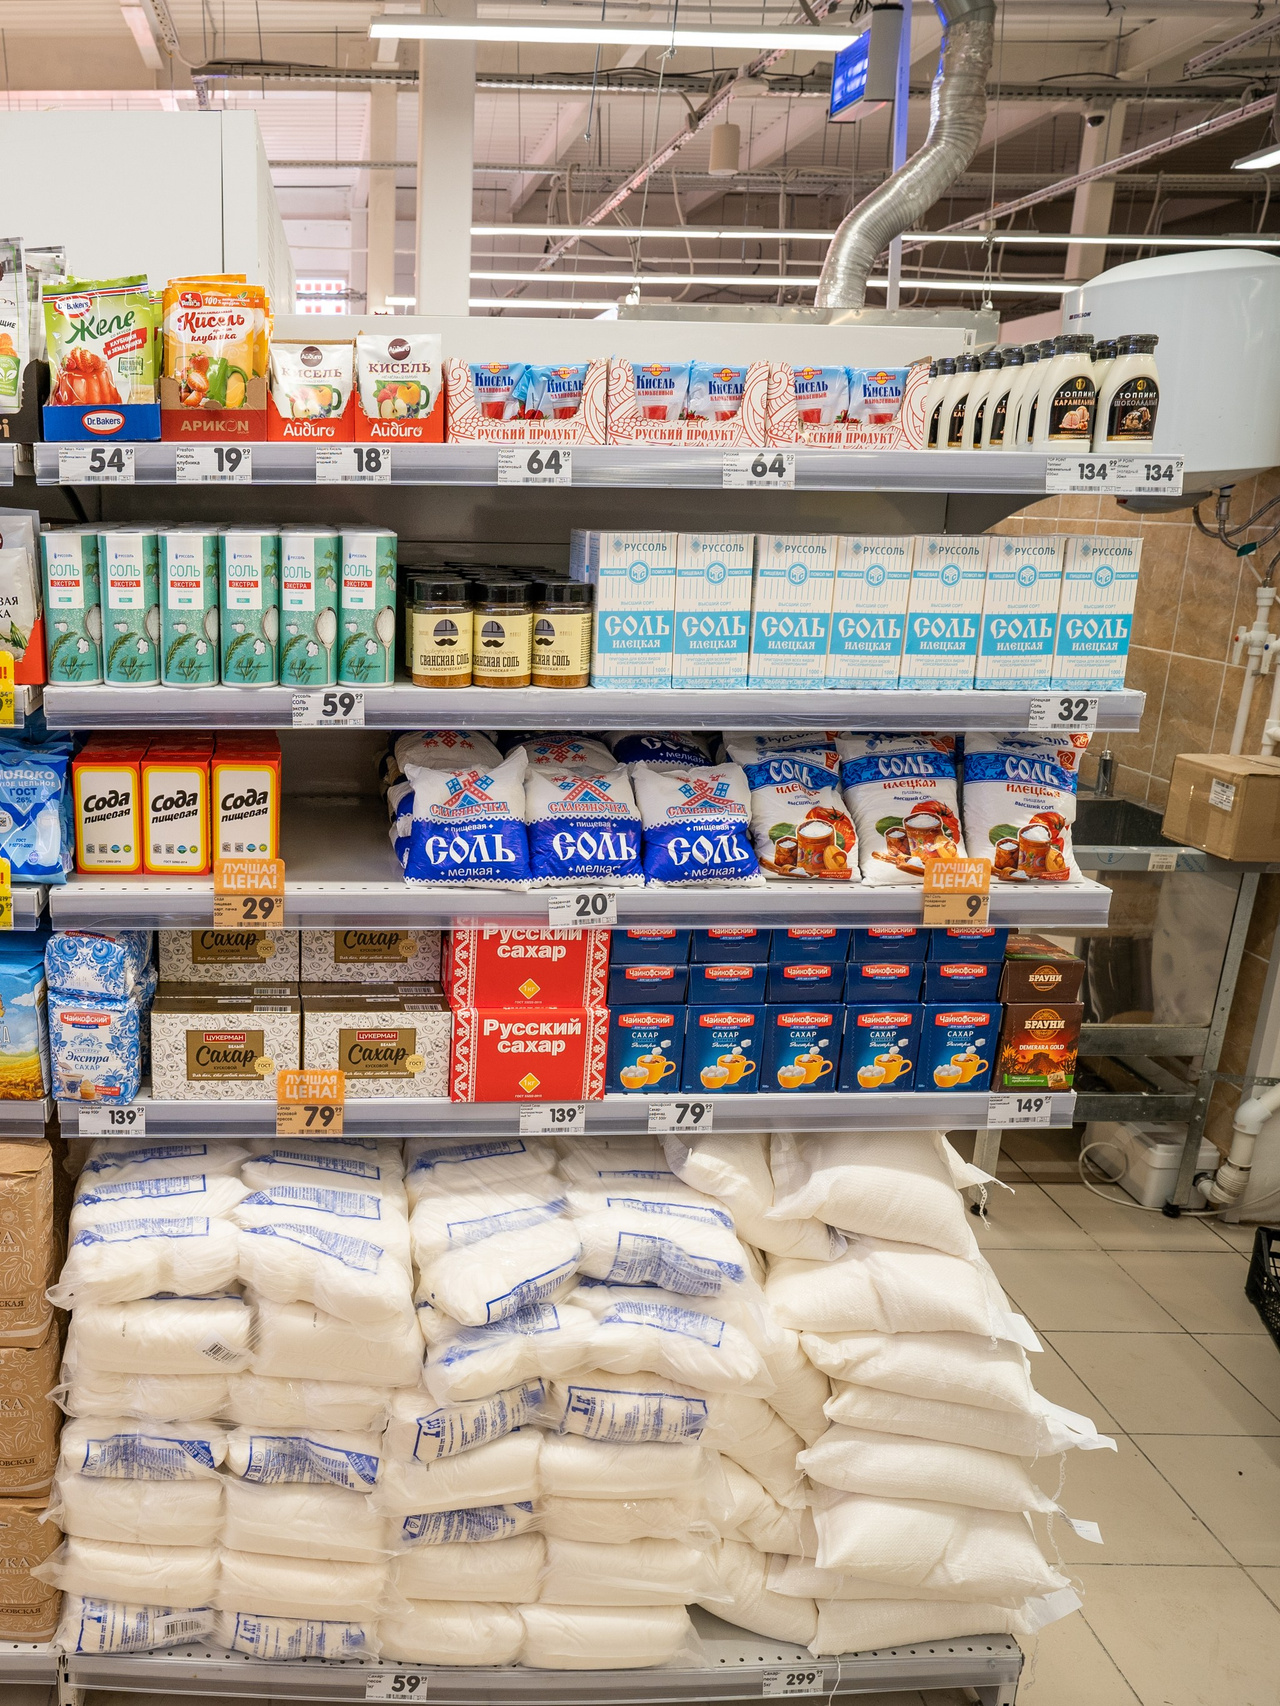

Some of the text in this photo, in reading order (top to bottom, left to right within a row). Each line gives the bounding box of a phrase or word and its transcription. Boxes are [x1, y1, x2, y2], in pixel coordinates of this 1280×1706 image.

[65, 311, 135, 344] Желе
[178, 311, 245, 332] Кисель
[191, 331, 237, 344] клубника
[369, 363, 431, 374] КИСЕЛЬ
[1119, 392, 1156, 400] ТОППИНГ
[478, 427, 526, 440] РУССКИЙ
[846, 432, 894, 446] ПРОДУКТ
[89, 448, 124, 472] 54
[215, 448, 241, 472] 19
[354, 448, 380, 472] 18
[527, 450, 562, 474] 64
[751, 454, 785, 477] 64
[1079, 463, 1107, 480] 134
[1145, 464, 1174, 481] 134
[785, 544, 827, 554] РУССОЛЬ
[863, 546, 904, 556] РУССОЛЬ
[762, 616, 825, 639] СОЛЬ
[990, 617, 1052, 640] СОЛЬ
[768, 641, 815, 651] ИЛЕЦКАЯ
[322, 693, 355, 716] 59
[1059, 698, 1088, 721] 32
[84, 790, 130, 813] Сода
[221, 788, 269, 811] Сода
[151, 808, 198, 825] пищевая
[430, 802, 509, 817] СЛАВЯНОЧКА
[666, 802, 747, 817] СЛАВЯНОЧКА
[425, 835, 516, 864] СОЛЬ
[552, 832, 637, 861] СОЛЬ
[668, 835, 749, 866] СОЛЬ
[223, 863, 277, 876] ЛУЧШАЯ
[691, 866, 735, 878] мелкая
[932, 862, 984, 874] ЛУЧШАЯ
[932, 872, 983, 888] ЦЕНА!
[242, 898, 275, 920] 29
[576, 893, 608, 916] 20
[966, 895, 981, 918] 9
[497, 944, 567, 962] сахар
[483, 1018, 581, 1037] Русский
[781, 1015, 831, 1024] Чайкофский
[861, 1014, 911, 1024] Чайкофский
[1024, 1020, 1065, 1030] БРАУНИ
[206, 1033, 244, 1042] ЦУКЕРМАН
[65, 1054, 109, 1064] Экстра
[347, 1044, 409, 1065] Сахар
[74, 1063, 100, 1071] САХАР
[285, 1084, 337, 1099] ЦЕНА!
[675, 1103, 705, 1124] 79
[1016, 1098, 1043, 1113] 149
[108, 1110, 136, 1125] 139
[304, 1106, 335, 1127] 79
[550, 1108, 576, 1123] 139
[392, 1676, 420, 1693] 59
[787, 1673, 816, 1685] 299
